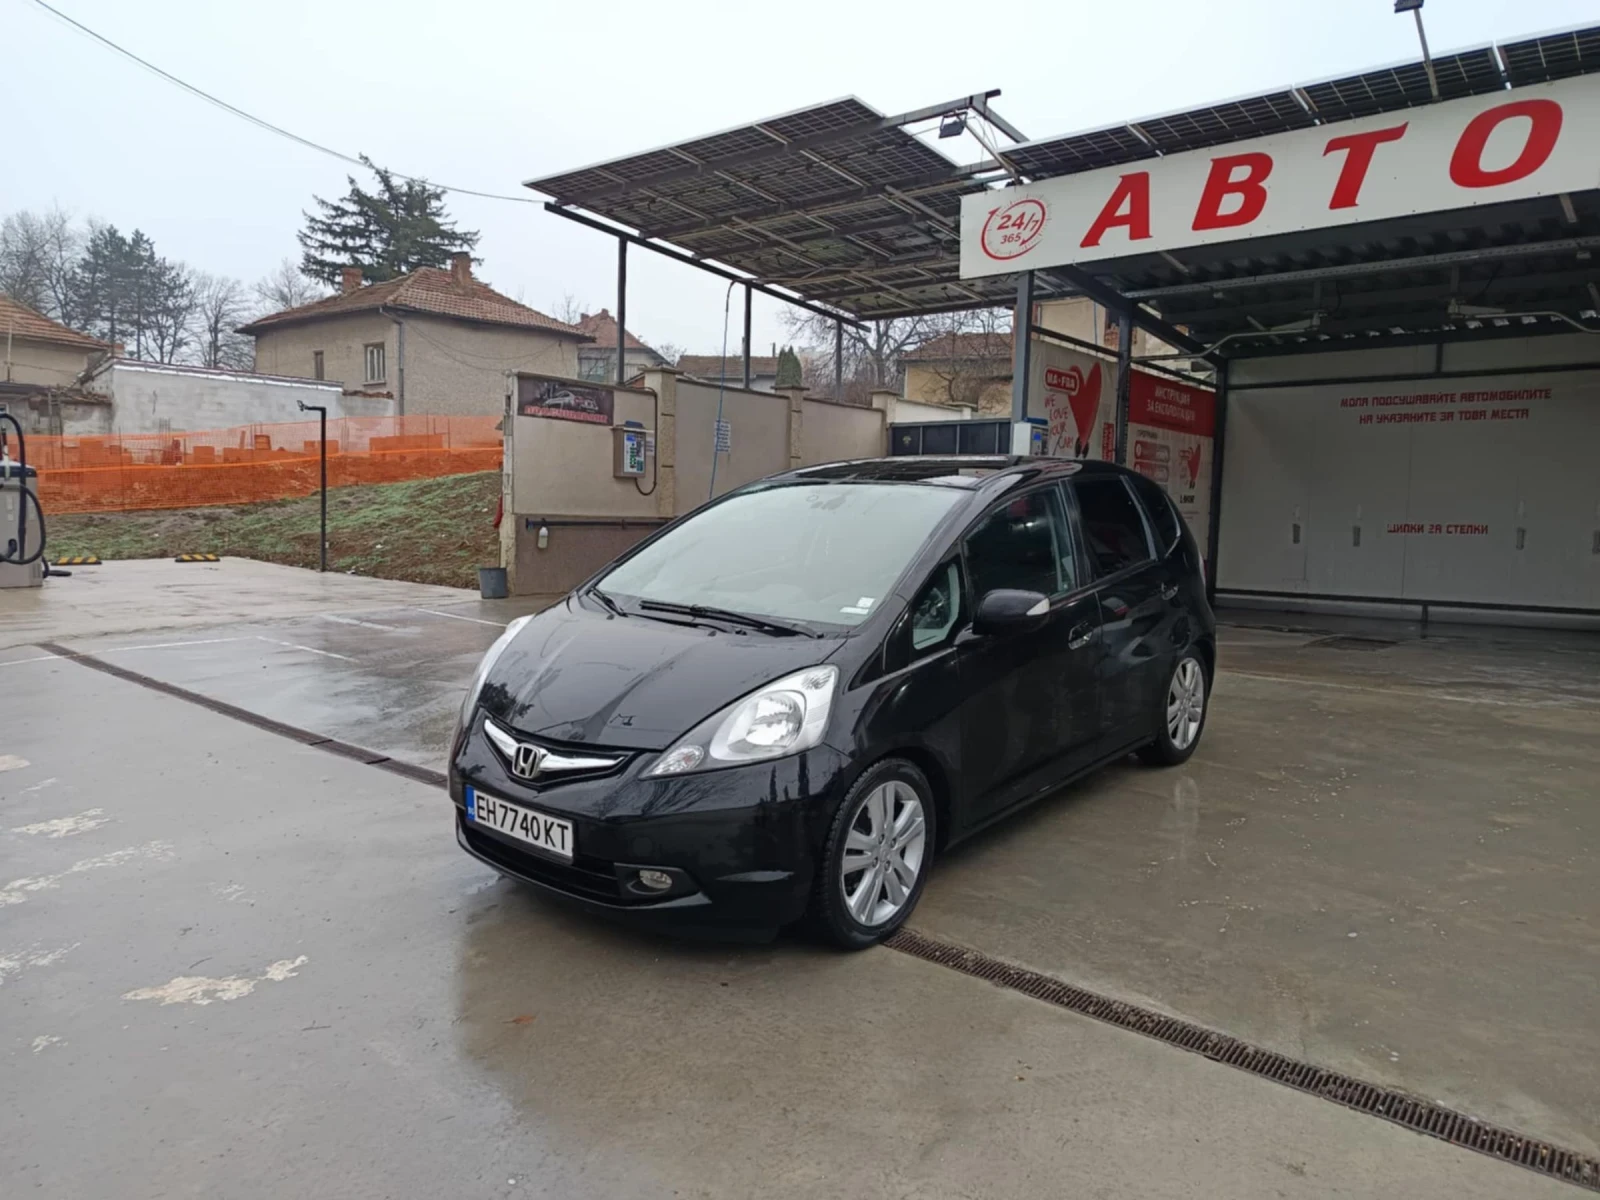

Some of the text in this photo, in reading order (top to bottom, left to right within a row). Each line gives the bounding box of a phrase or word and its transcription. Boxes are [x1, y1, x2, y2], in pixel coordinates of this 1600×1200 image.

[1081, 101, 1562, 247] АВТО
[997, 212, 1039, 233] 24/7
[1000, 233, 1023, 246] 365
[1340, 388, 1552, 409] МОЛЯ ПОДСУШАВАЙТЕ АВТОМОБИЛИТЕ
[1049, 406, 1068, 421] LOVE
[1359, 408, 1529, 424] НА УКАЗАНИТЕ ЗА ТОВА МЕСТА
[1446, 524, 1489, 535] СТЕЛКИ
